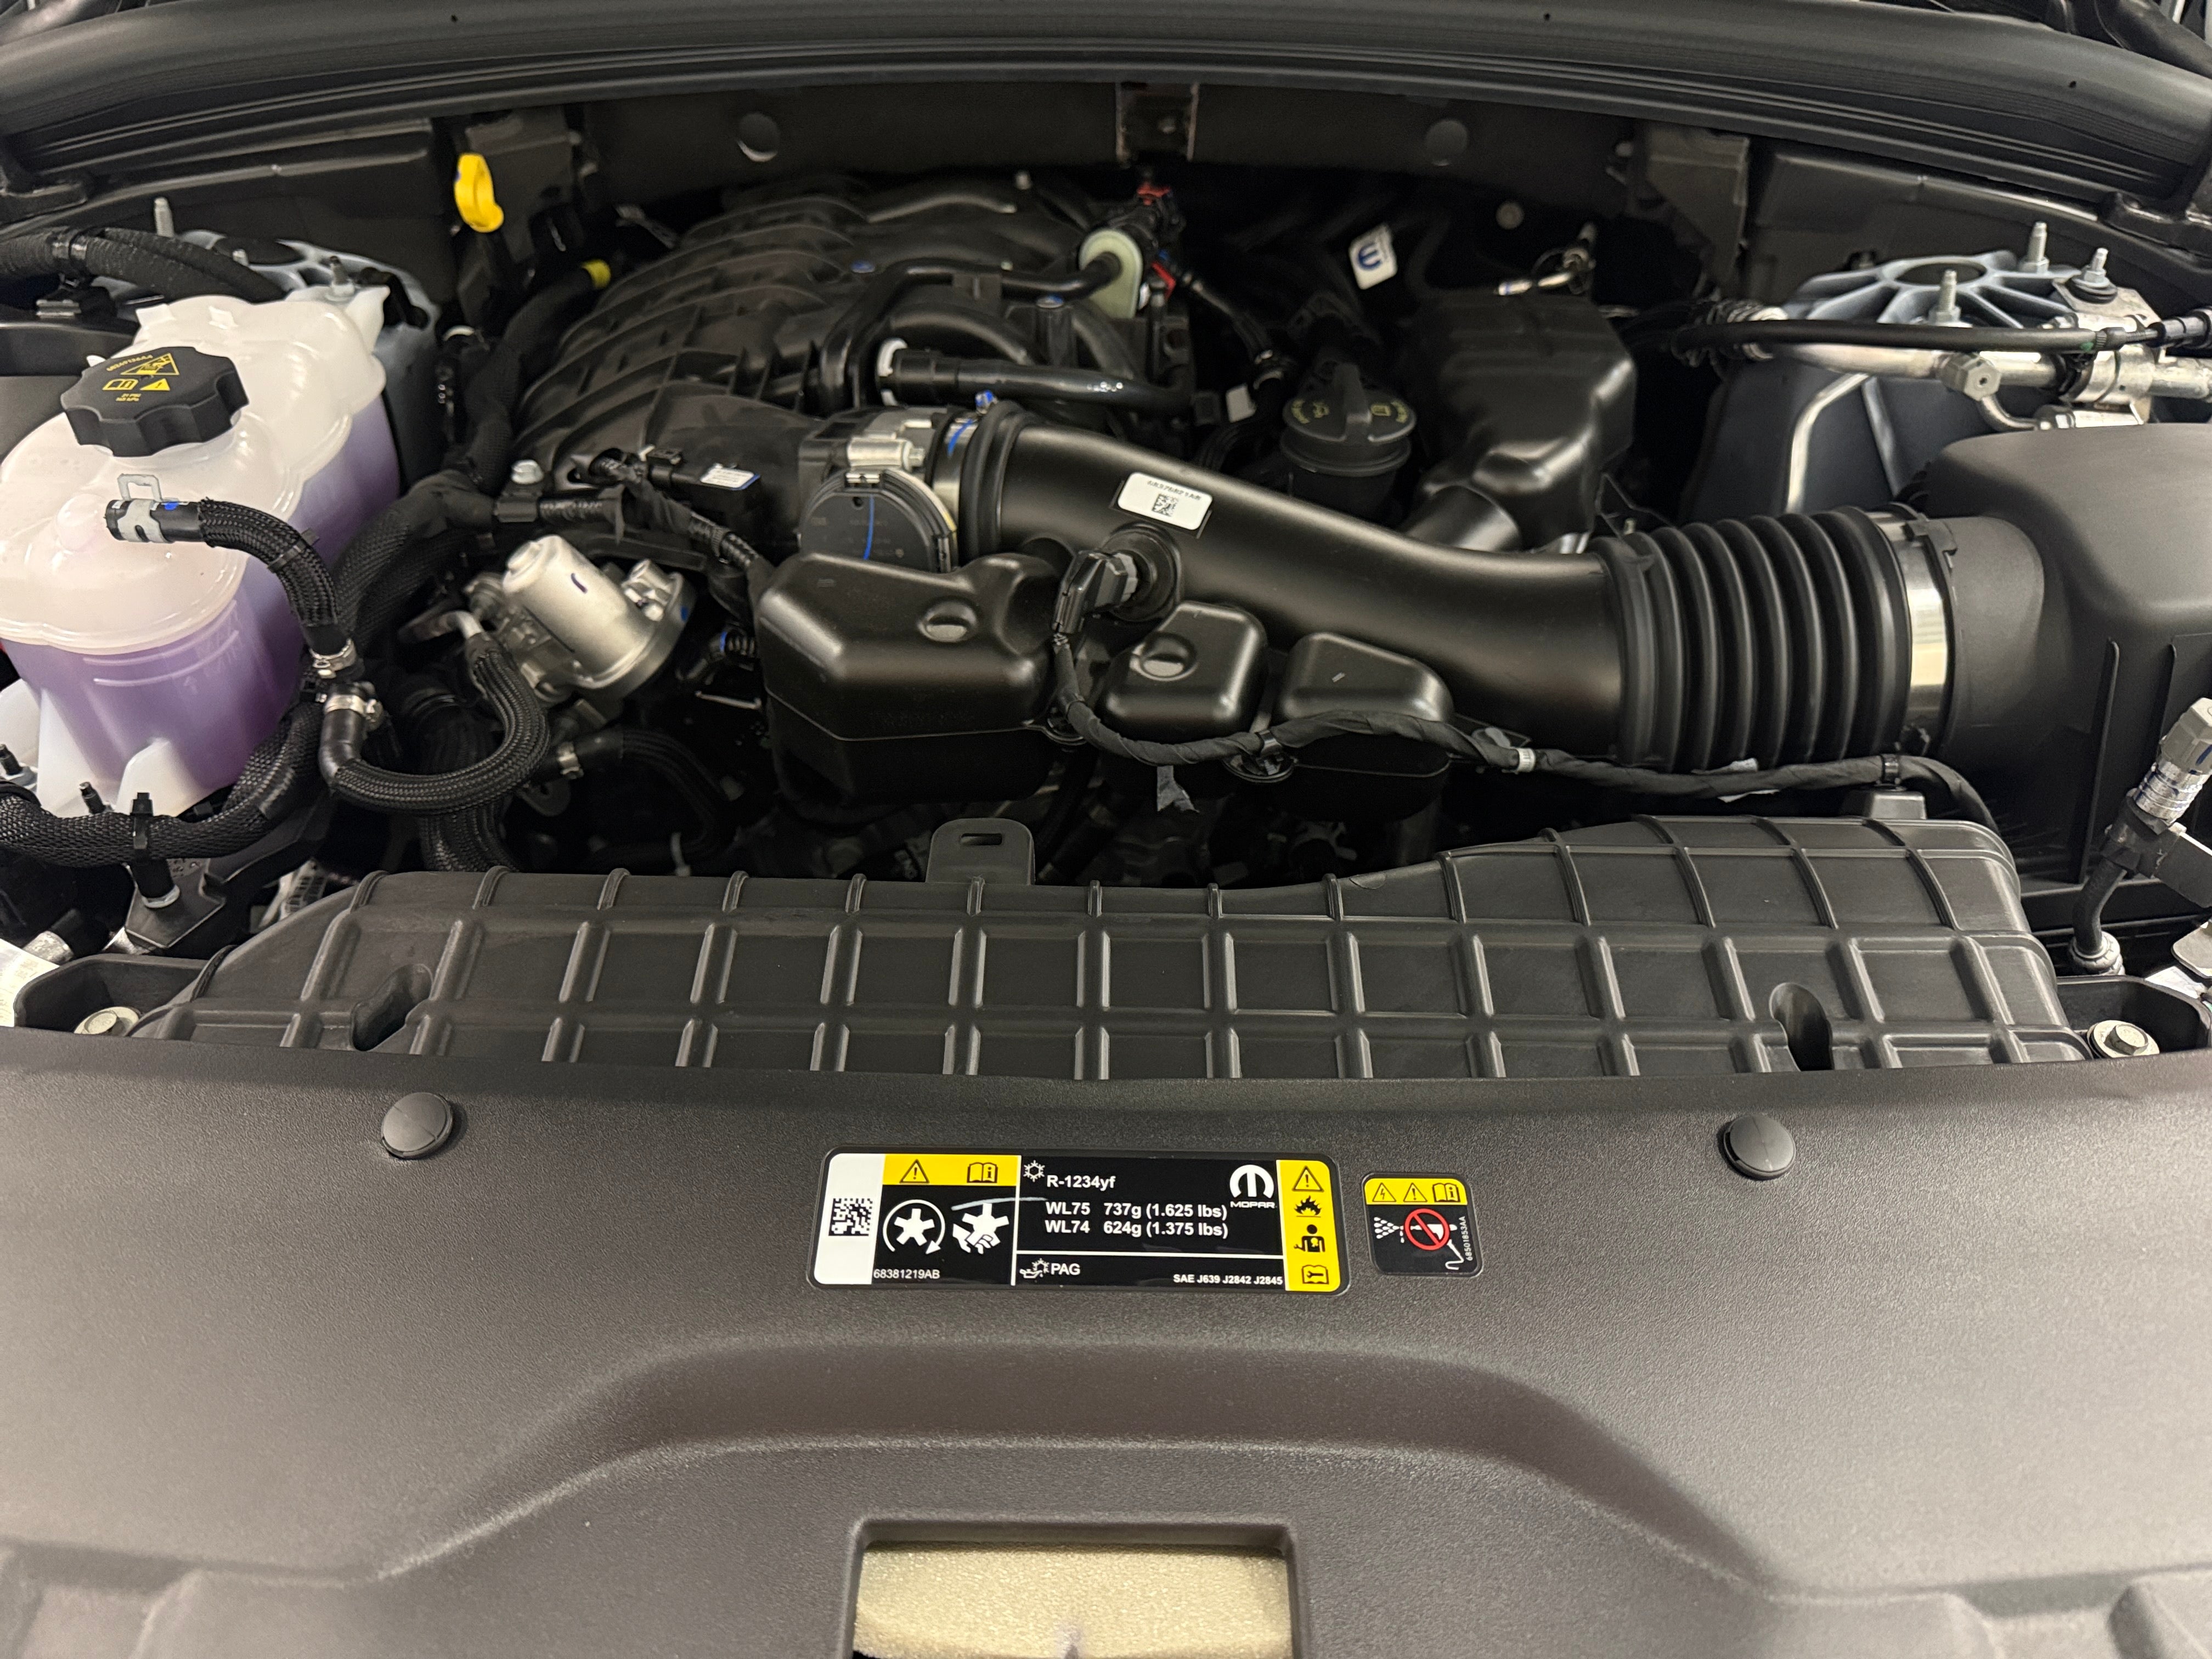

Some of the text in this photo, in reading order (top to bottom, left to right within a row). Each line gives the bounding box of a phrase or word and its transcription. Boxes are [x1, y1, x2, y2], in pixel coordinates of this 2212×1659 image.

[1047, 1175, 1116, 1192] R-1234yf
[1046, 1201, 1227, 1221] WL75 737g (1.625 lbs)
[1045, 1220, 1228, 1239] WL74 624g (1.375 lbs)
[873, 1269, 940, 1279] 68381219AB
[1051, 1262, 1081, 1276] PAG
[1173, 1274, 1283, 1285] SAE J639 J2842 J2845
